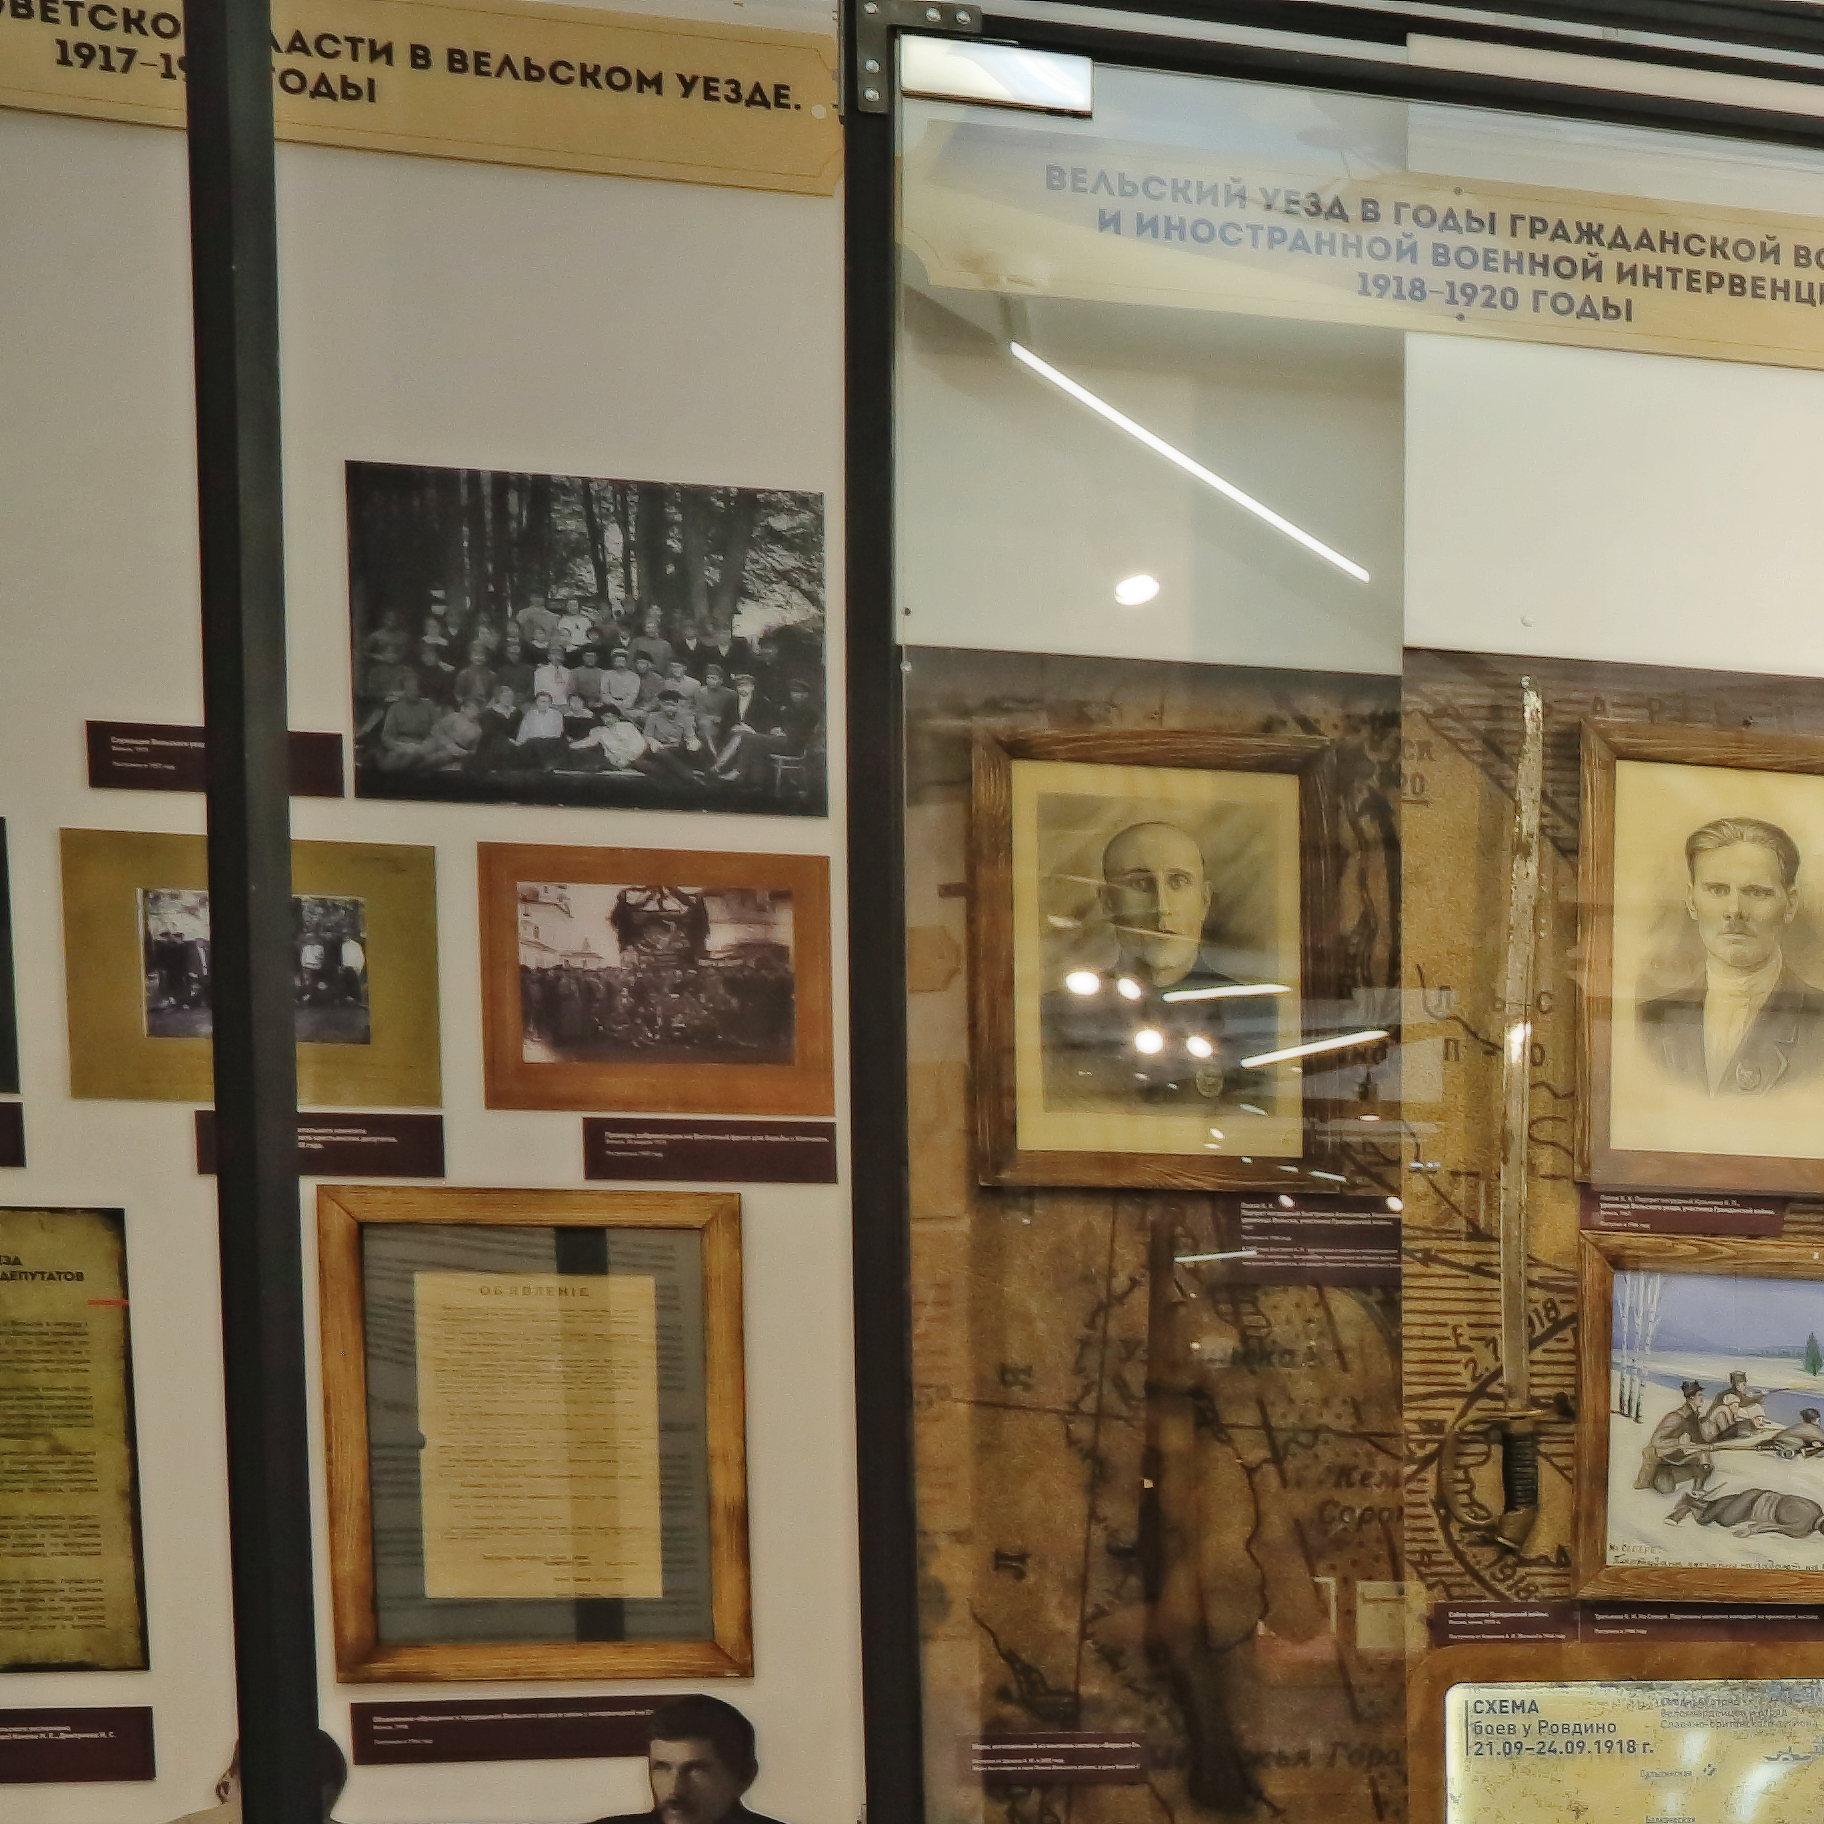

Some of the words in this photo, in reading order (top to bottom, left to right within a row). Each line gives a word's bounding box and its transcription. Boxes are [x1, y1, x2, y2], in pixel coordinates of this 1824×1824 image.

[272, 66, 376, 103] ОДЫ
[410, 43, 432, 70] В
[447, 48, 663, 96] ВЕЛЬСКОМ
[676, 72, 801, 110] УЕЗДЕ.
[1045, 164, 1246, 209] ВЕЛЬСКИЙ
[1259, 186, 1349, 223] УЕЗД
[1361, 197, 1381, 223] В
[1394, 201, 1496, 236] ГОДЫ
[1510, 212, 1781, 266] ГРАЖДАНСКОЙ
[1098, 208, 1121, 234] И
[1136, 212, 1418, 265] ИНОСТРАННОЙ
[1432, 240, 1603, 283] ВОЕННОЙ
[1532, 289, 1633, 322] ГОДЫ
[1473, 1699, 1539, 1715] СХЕМА
[1473, 1721, 1517, 1735] боев
[1522, 1723, 1532, 1737] у
[1538, 1720, 1617, 1735] Ровдино
[1642, 1742, 1654, 1754] г.
